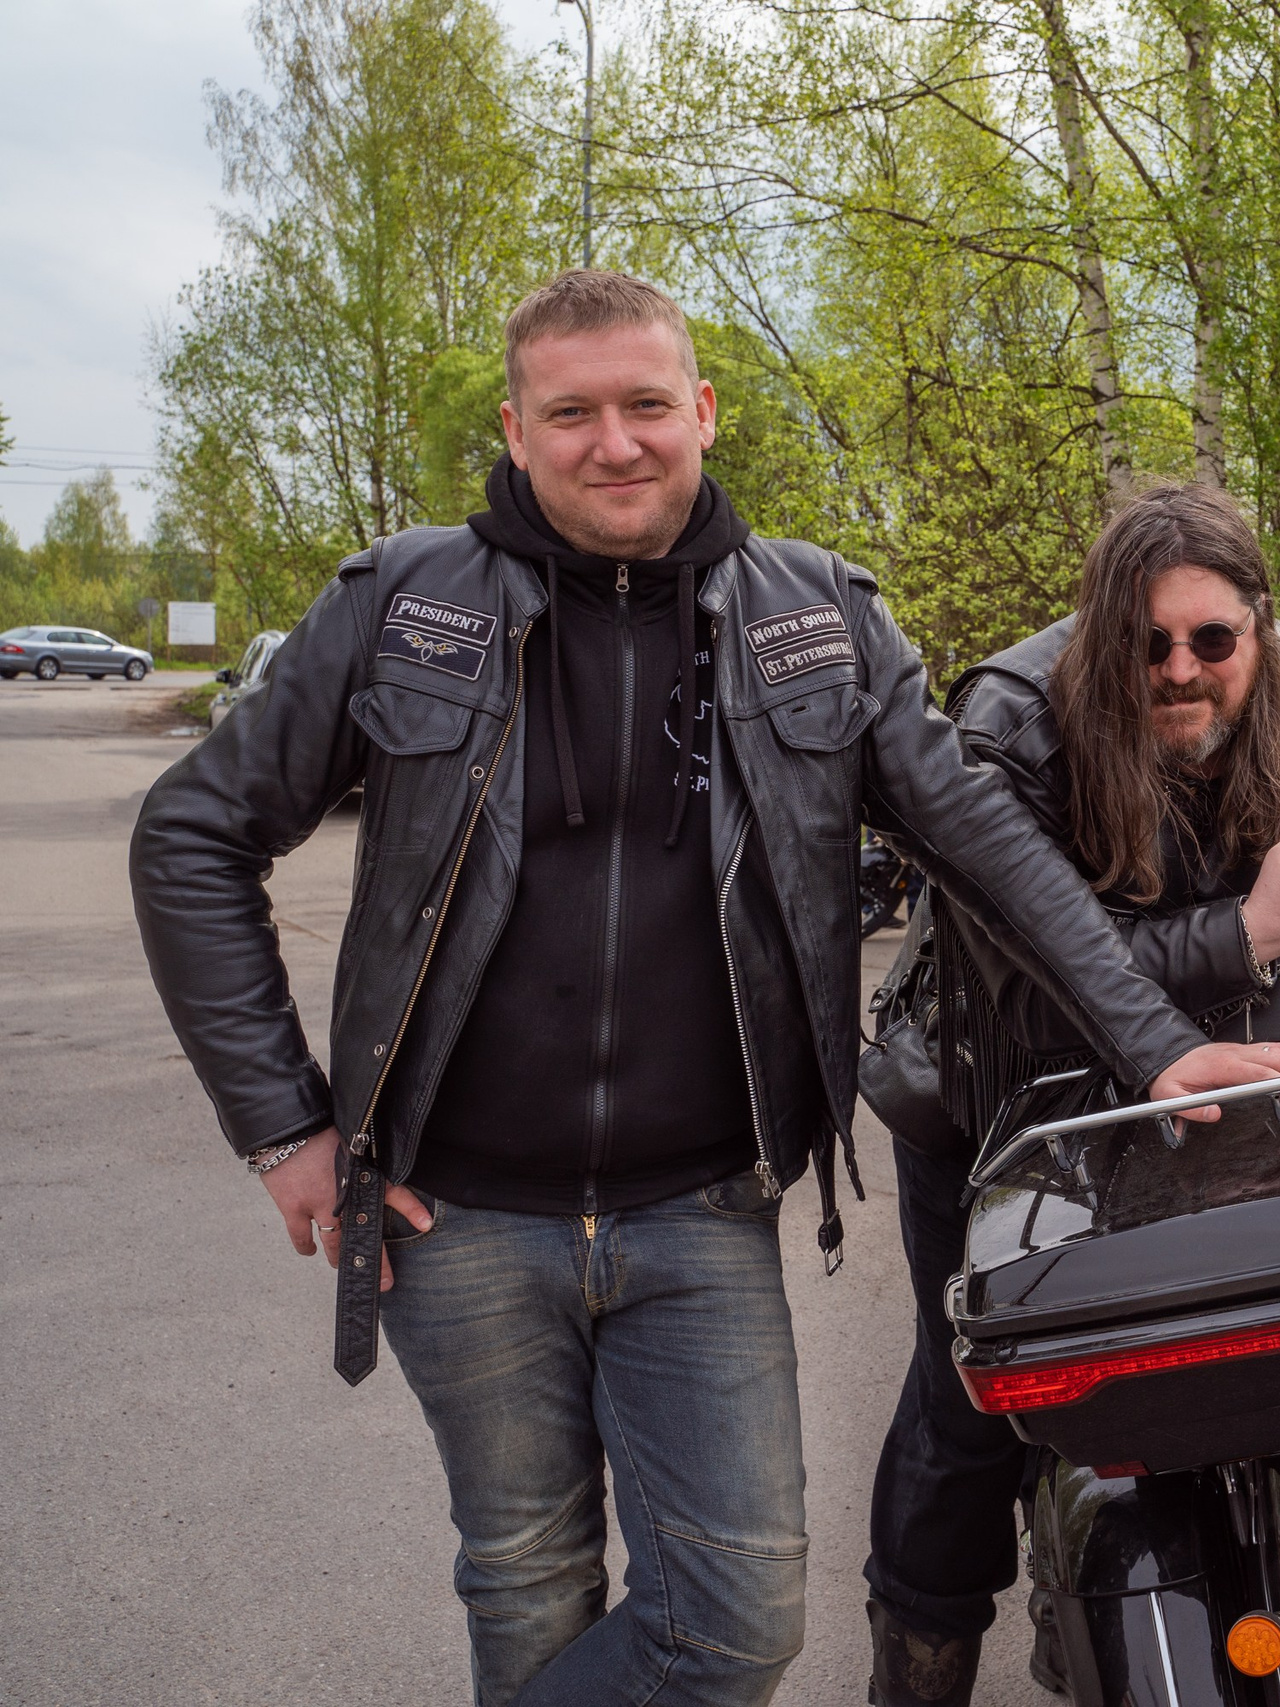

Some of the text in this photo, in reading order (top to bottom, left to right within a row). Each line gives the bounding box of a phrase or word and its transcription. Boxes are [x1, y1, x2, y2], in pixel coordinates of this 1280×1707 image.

[395, 600, 484, 632] PRESIDENT
[751, 611, 840, 645] NORTH SQUAD
